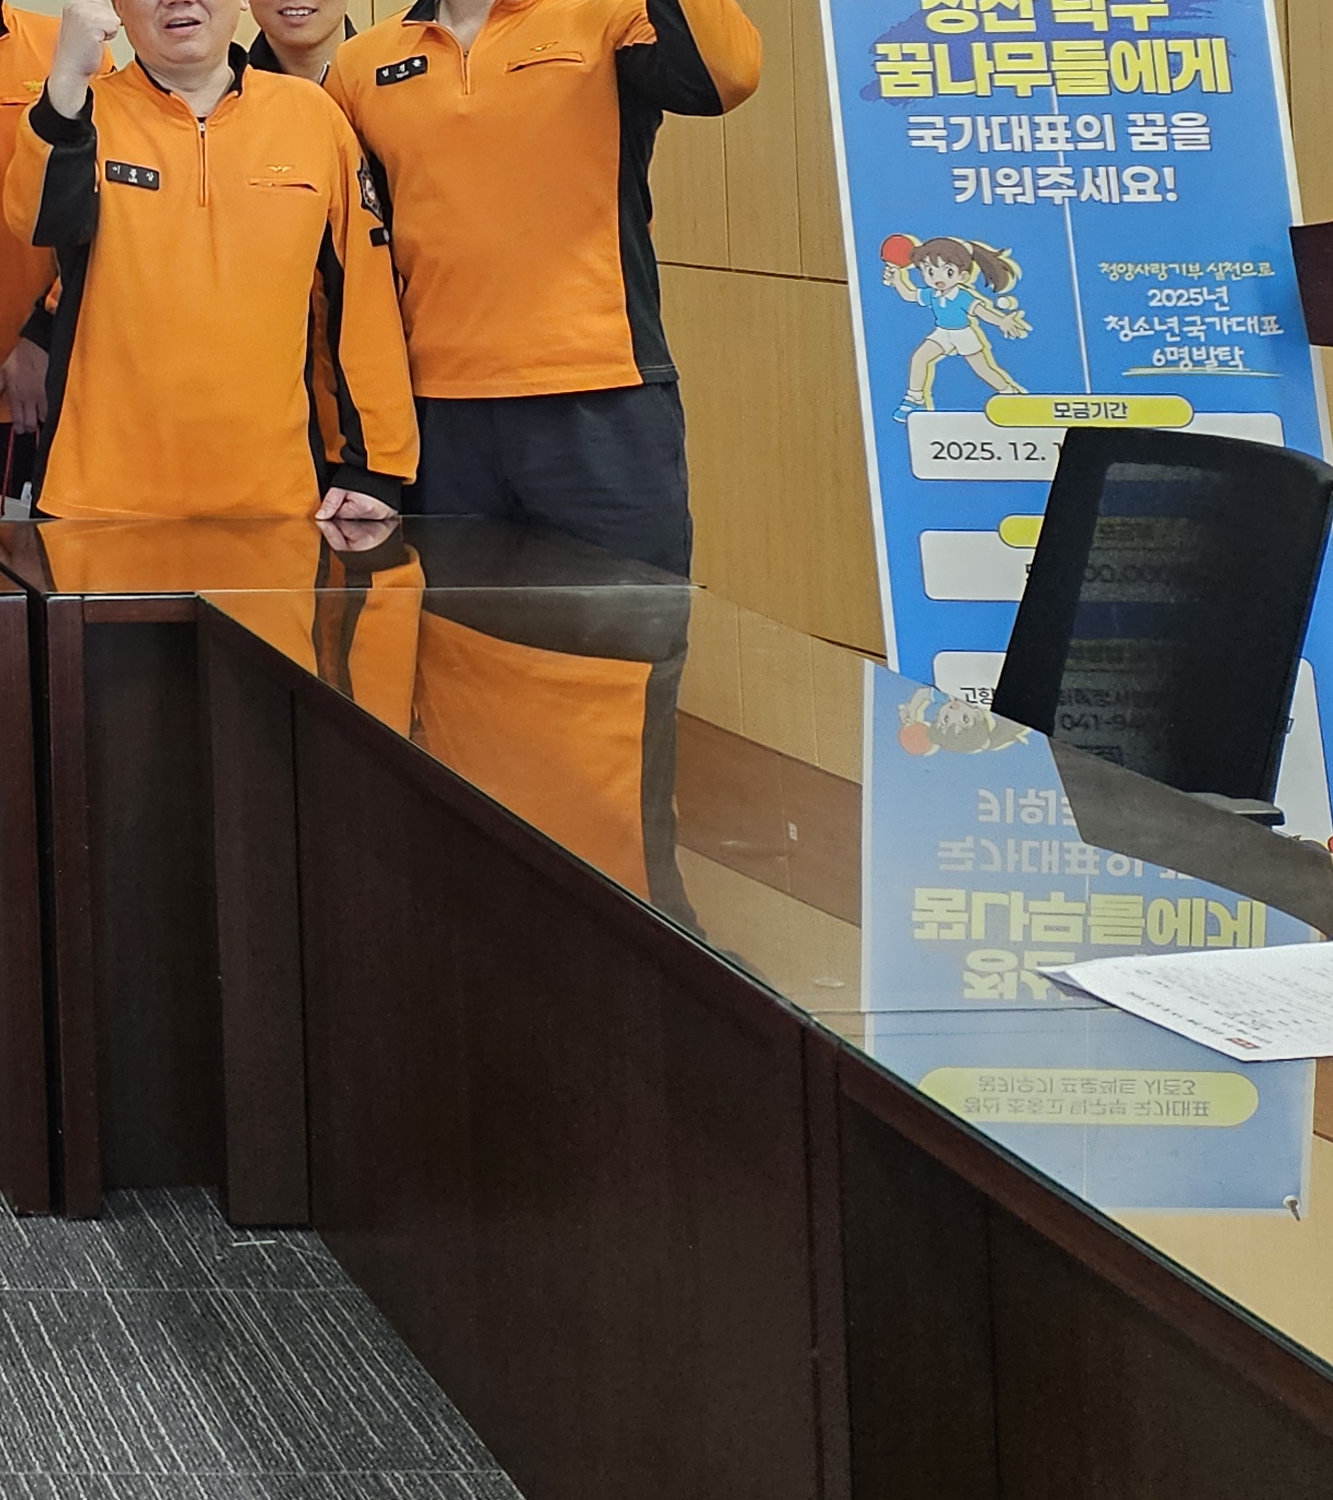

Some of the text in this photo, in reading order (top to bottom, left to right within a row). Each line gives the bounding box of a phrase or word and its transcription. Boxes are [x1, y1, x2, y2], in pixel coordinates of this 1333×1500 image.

[873, 36, 1233, 99] 꿈나무들에게
[905, 111, 1213, 155] 국가대표의 꿈을
[951, 165, 1179, 206] 키워주세요!
[1097, 260, 1276, 283] 청양사랑기부 실천으로
[1147, 286, 1231, 313] 2025년
[1053, 401, 1129, 421] 모금기간
[929, 440, 1003, 461] 2025.
[1008, 441, 1047, 461] 12.
